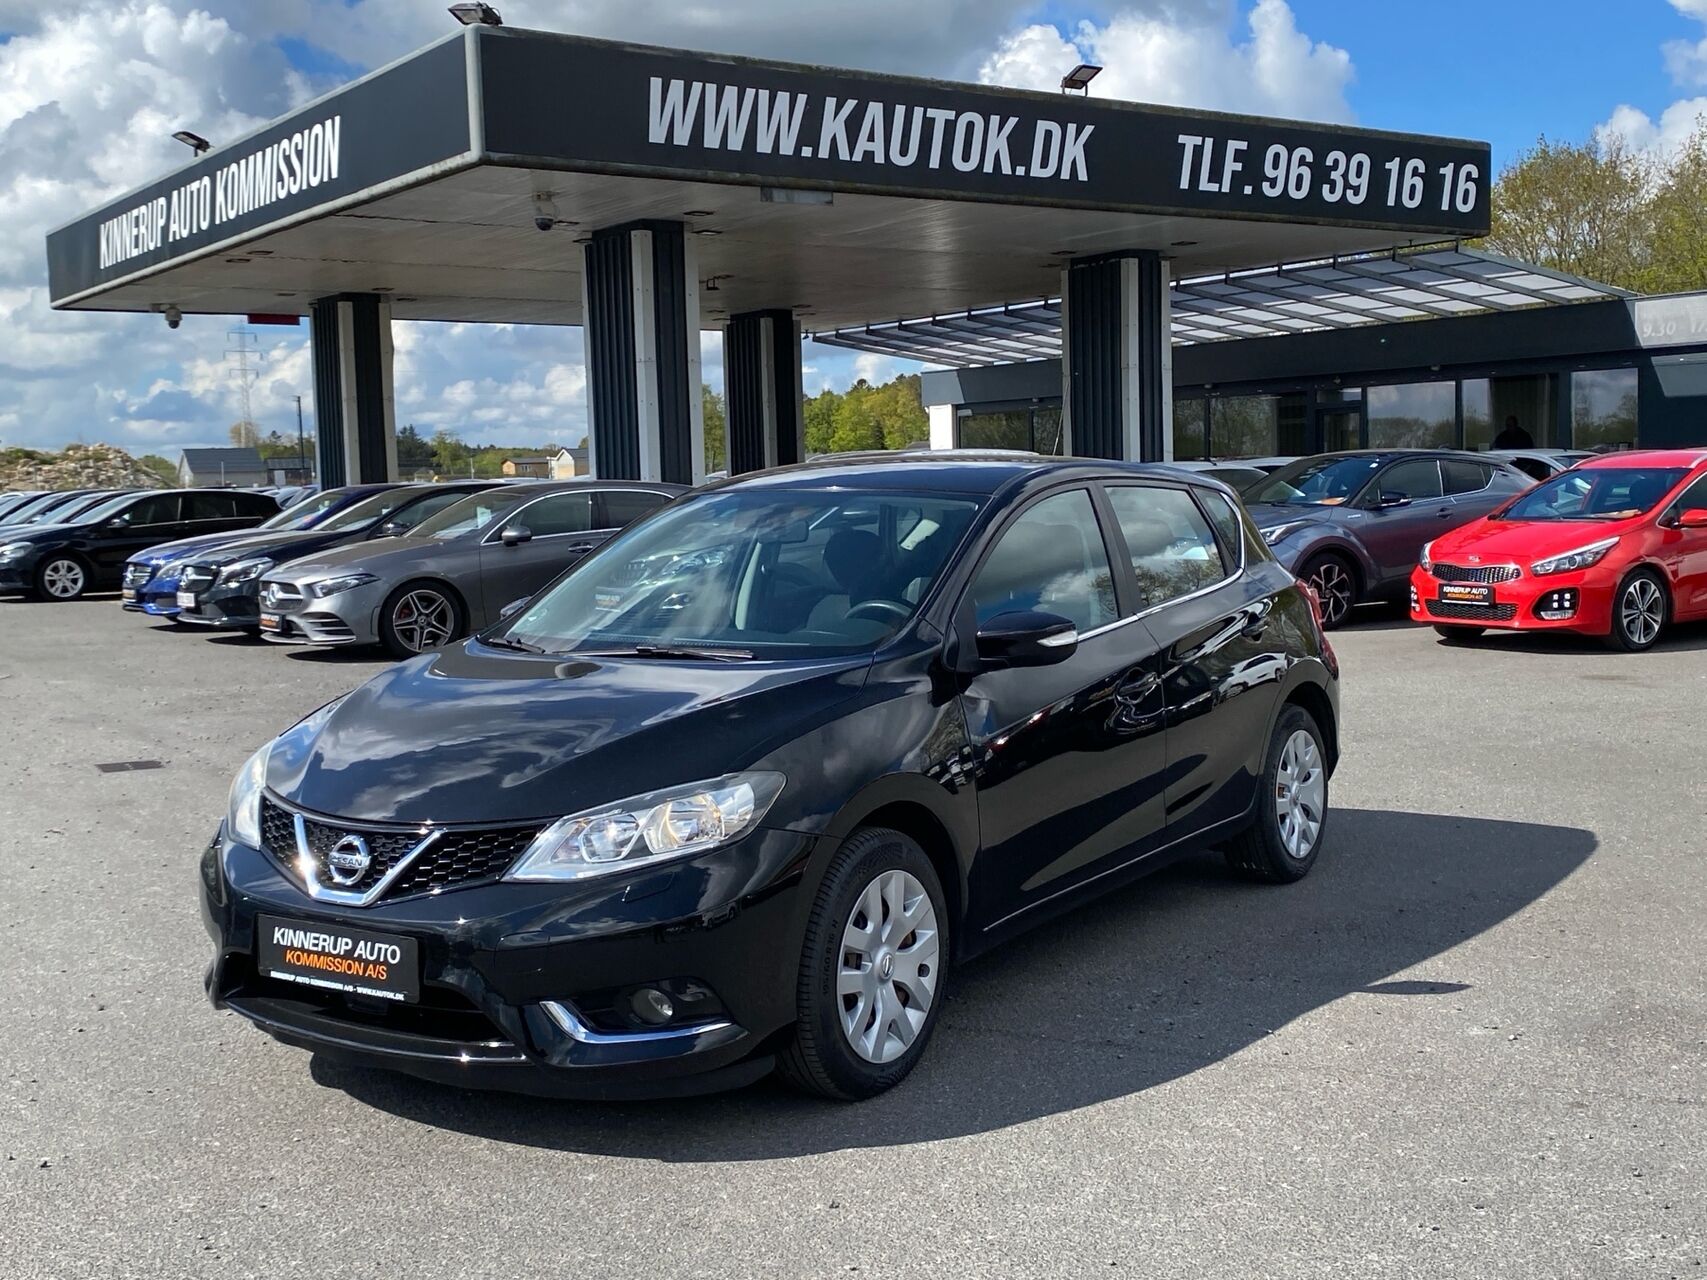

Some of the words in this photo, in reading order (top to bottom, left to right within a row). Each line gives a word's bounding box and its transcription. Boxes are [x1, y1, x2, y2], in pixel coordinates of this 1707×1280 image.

[649, 76, 1095, 182] WWW.KAUTOK.DK
[100, 197, 167, 269] KINNERUP
[169, 176, 210, 242] AUTO
[215, 115, 341, 224] KOMMISSION
[1178, 134, 1252, 195] TLF.
[1262, 144, 1313, 199] 96
[1321, 150, 1371, 205] 39
[1384, 156, 1425, 209] 16
[1439, 162, 1479, 213] 16
[329, 854, 362, 867] NSSAN
[273, 926, 353, 956] KINNERUP
[354, 940, 400, 965] AUTO
[286, 950, 363, 976] KOMMISSION
[365, 965, 387, 980] A/S
